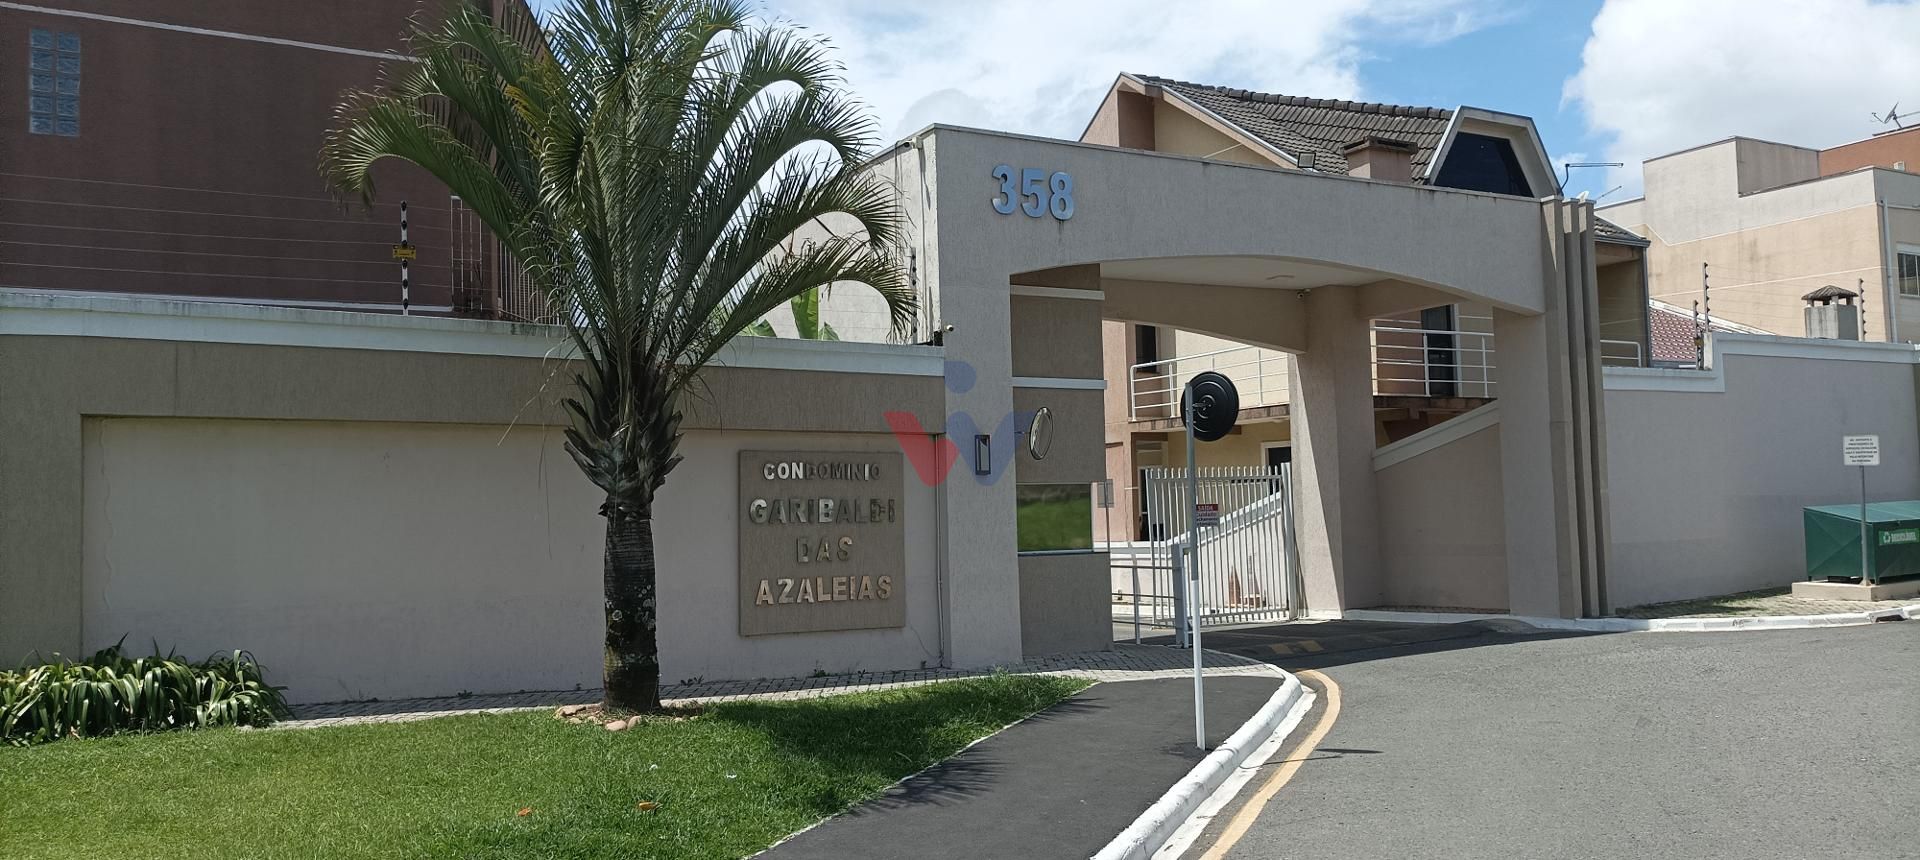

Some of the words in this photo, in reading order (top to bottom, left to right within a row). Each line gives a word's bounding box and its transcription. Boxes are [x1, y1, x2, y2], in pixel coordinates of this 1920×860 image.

[991, 165, 1074, 220] 358
[763, 462, 880, 480] CONDOMINIO
[750, 498, 896, 524] GARIBALDI
[797, 536, 853, 563] DAS
[756, 575, 892, 605] AZALEIAS
